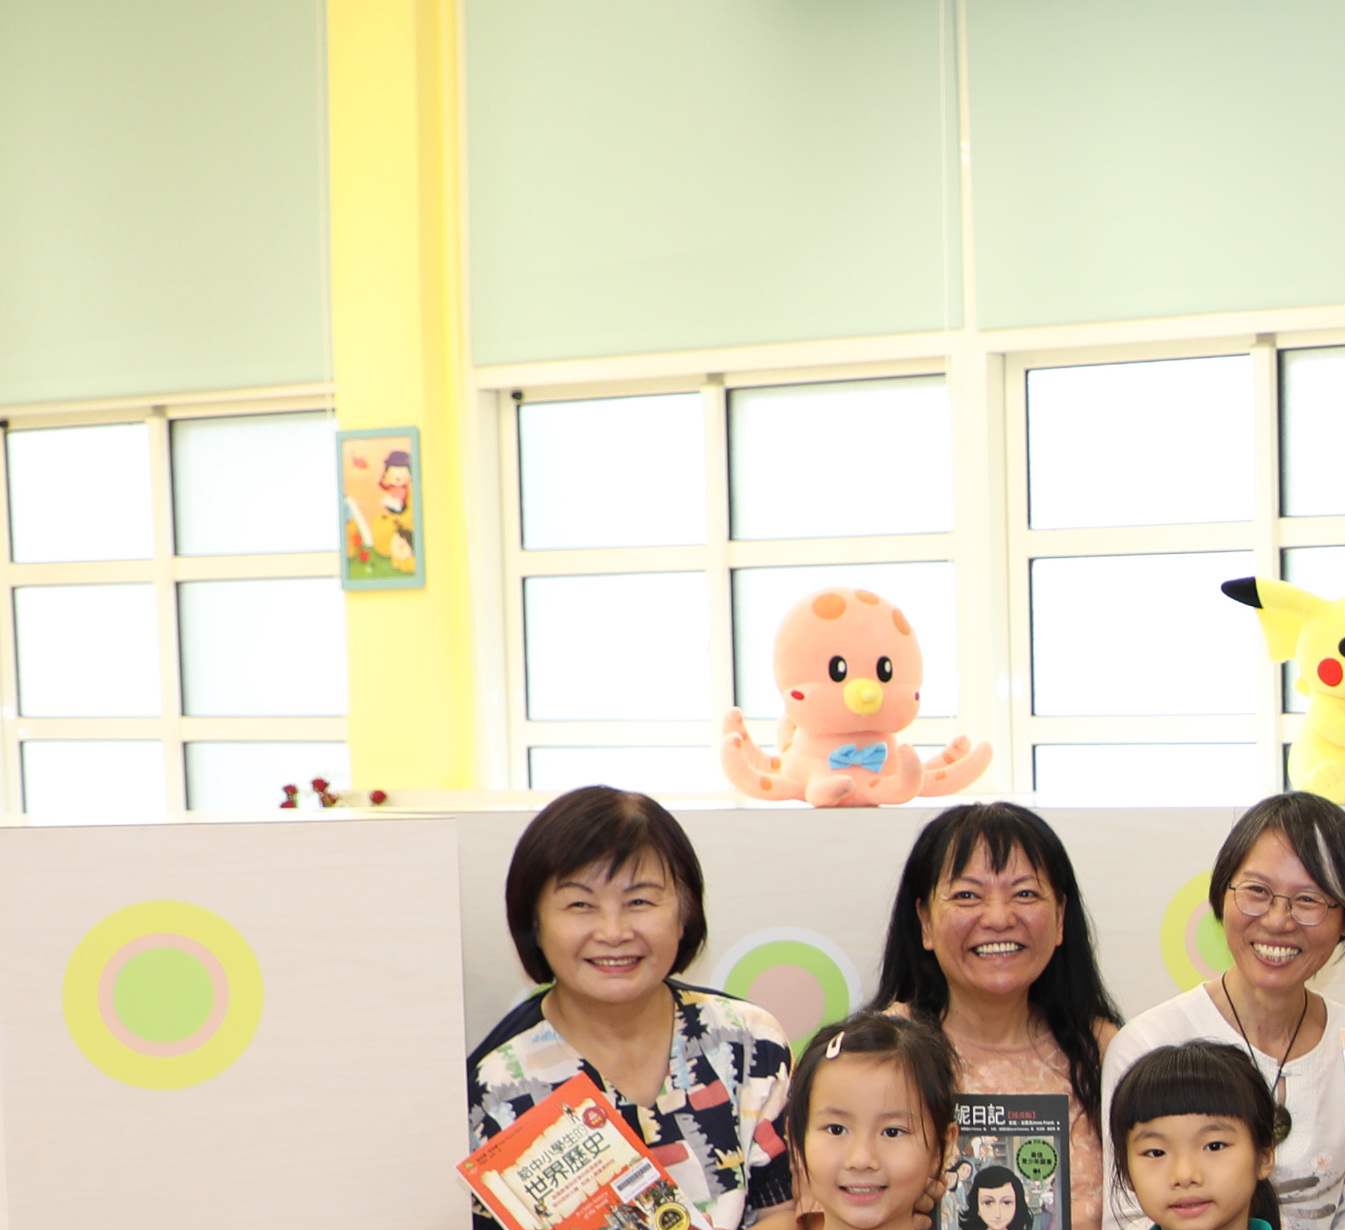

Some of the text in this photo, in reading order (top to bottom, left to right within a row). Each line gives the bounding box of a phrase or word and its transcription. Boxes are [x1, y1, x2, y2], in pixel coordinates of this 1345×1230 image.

[516, 1124, 589, 1182] 給中小學生的
[524, 1132, 612, 1202] 世界歷史
